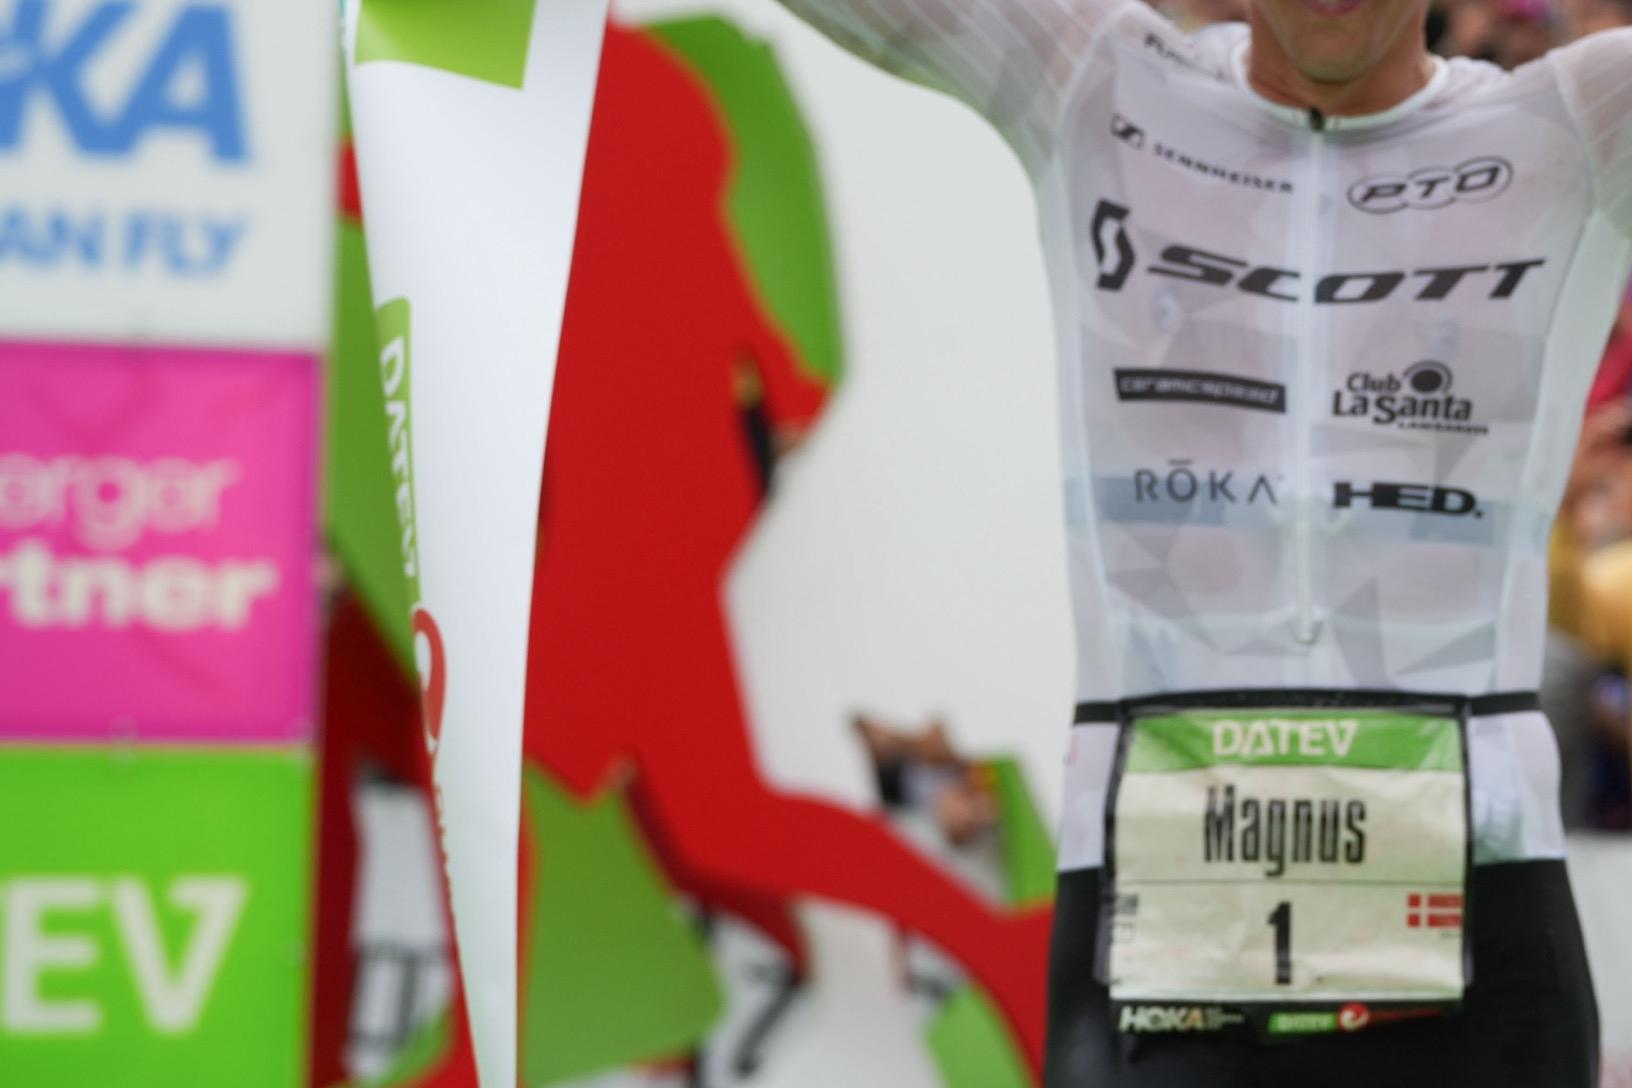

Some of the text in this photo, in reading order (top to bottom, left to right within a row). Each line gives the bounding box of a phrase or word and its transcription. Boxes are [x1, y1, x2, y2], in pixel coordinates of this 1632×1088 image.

[1357, 163, 1504, 206] PTO
[1147, 243, 1549, 305] SCOTT
[1346, 370, 1401, 392] Club
[0, 539, 280, 632] tner
[1211, 718, 1359, 757] DATEV
[1203, 783, 1367, 878] Magnus
[1266, 900, 1292, 986] 1
